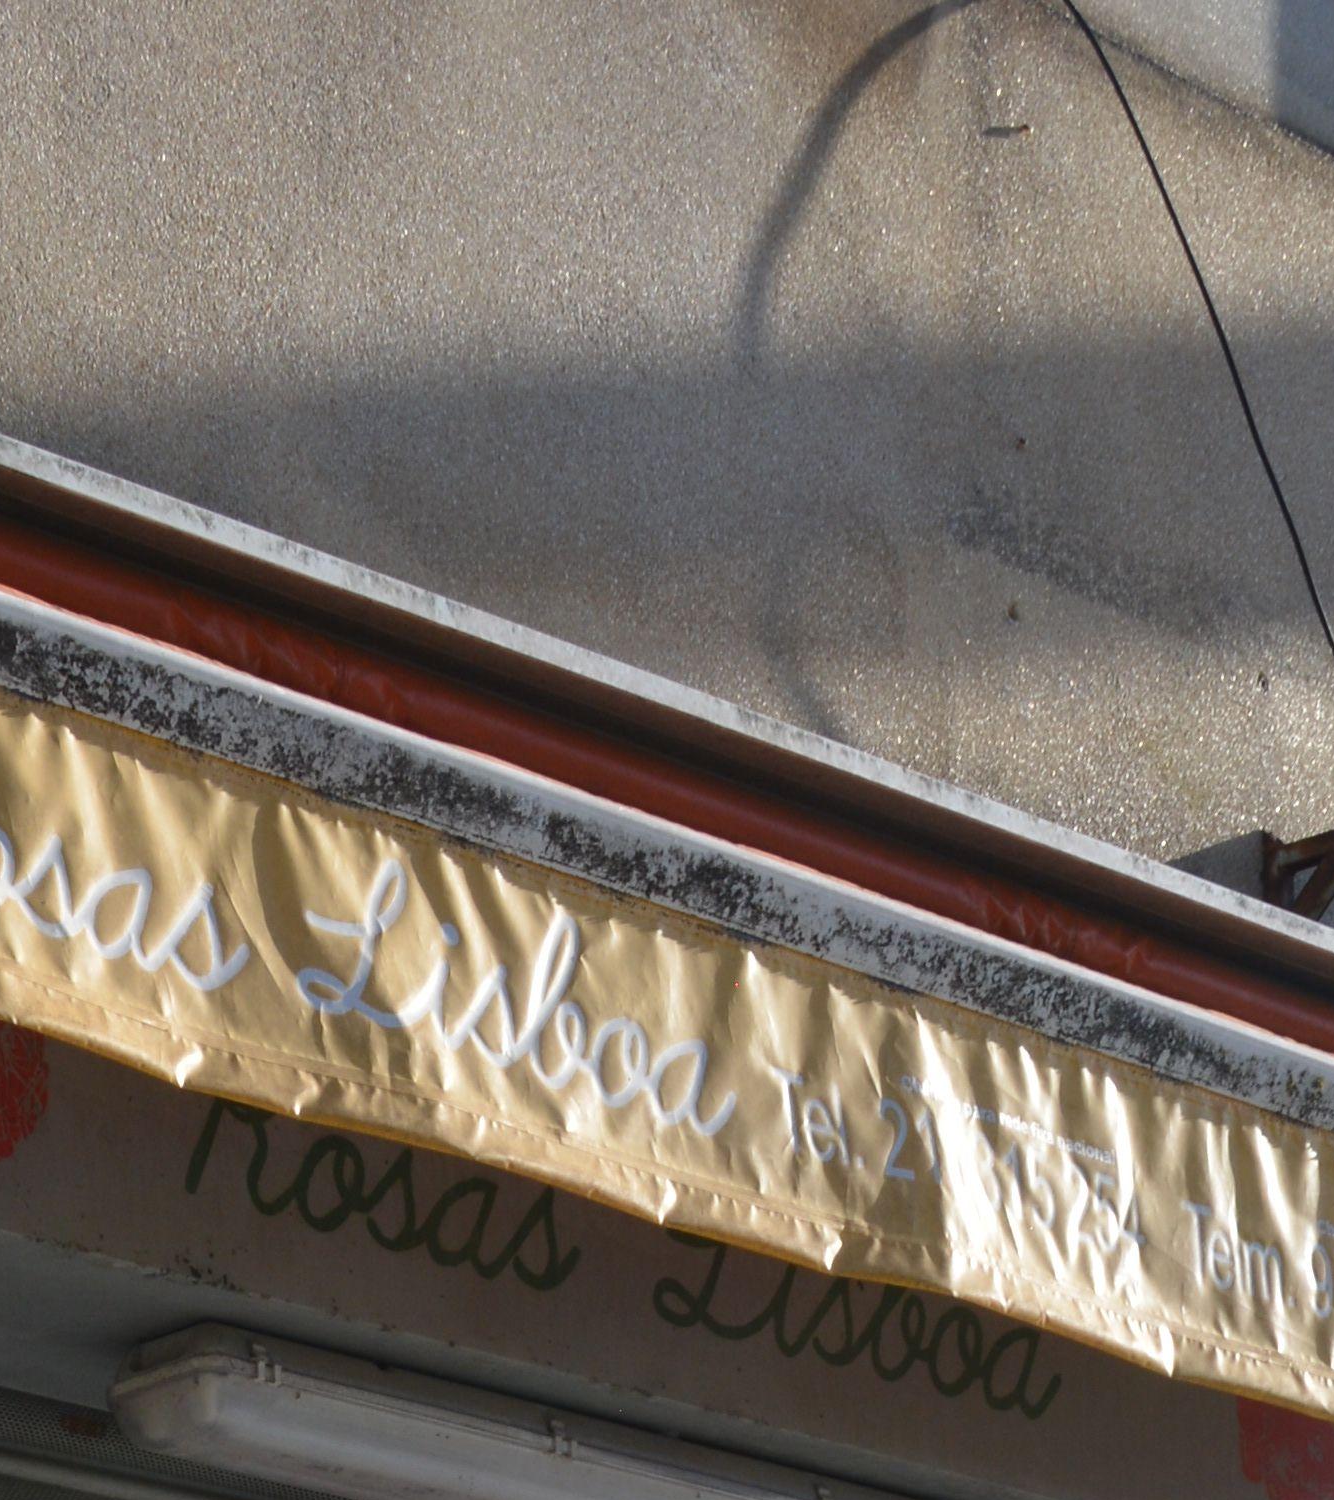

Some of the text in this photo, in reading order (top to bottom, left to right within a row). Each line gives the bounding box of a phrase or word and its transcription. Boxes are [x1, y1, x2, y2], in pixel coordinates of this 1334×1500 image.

[294, 858, 736, 1137] Lisboa
[770, 1066, 865, 1171] Tel.
[998, 1110, 1029, 1137] rede
[1028, 1121, 1055, 1146] fixa
[1056, 1134, 1116, 1167] nacional
[184, 1096, 1063, 1420] Rosas Lisboa
[1181, 1200, 1296, 1310] Telm.
